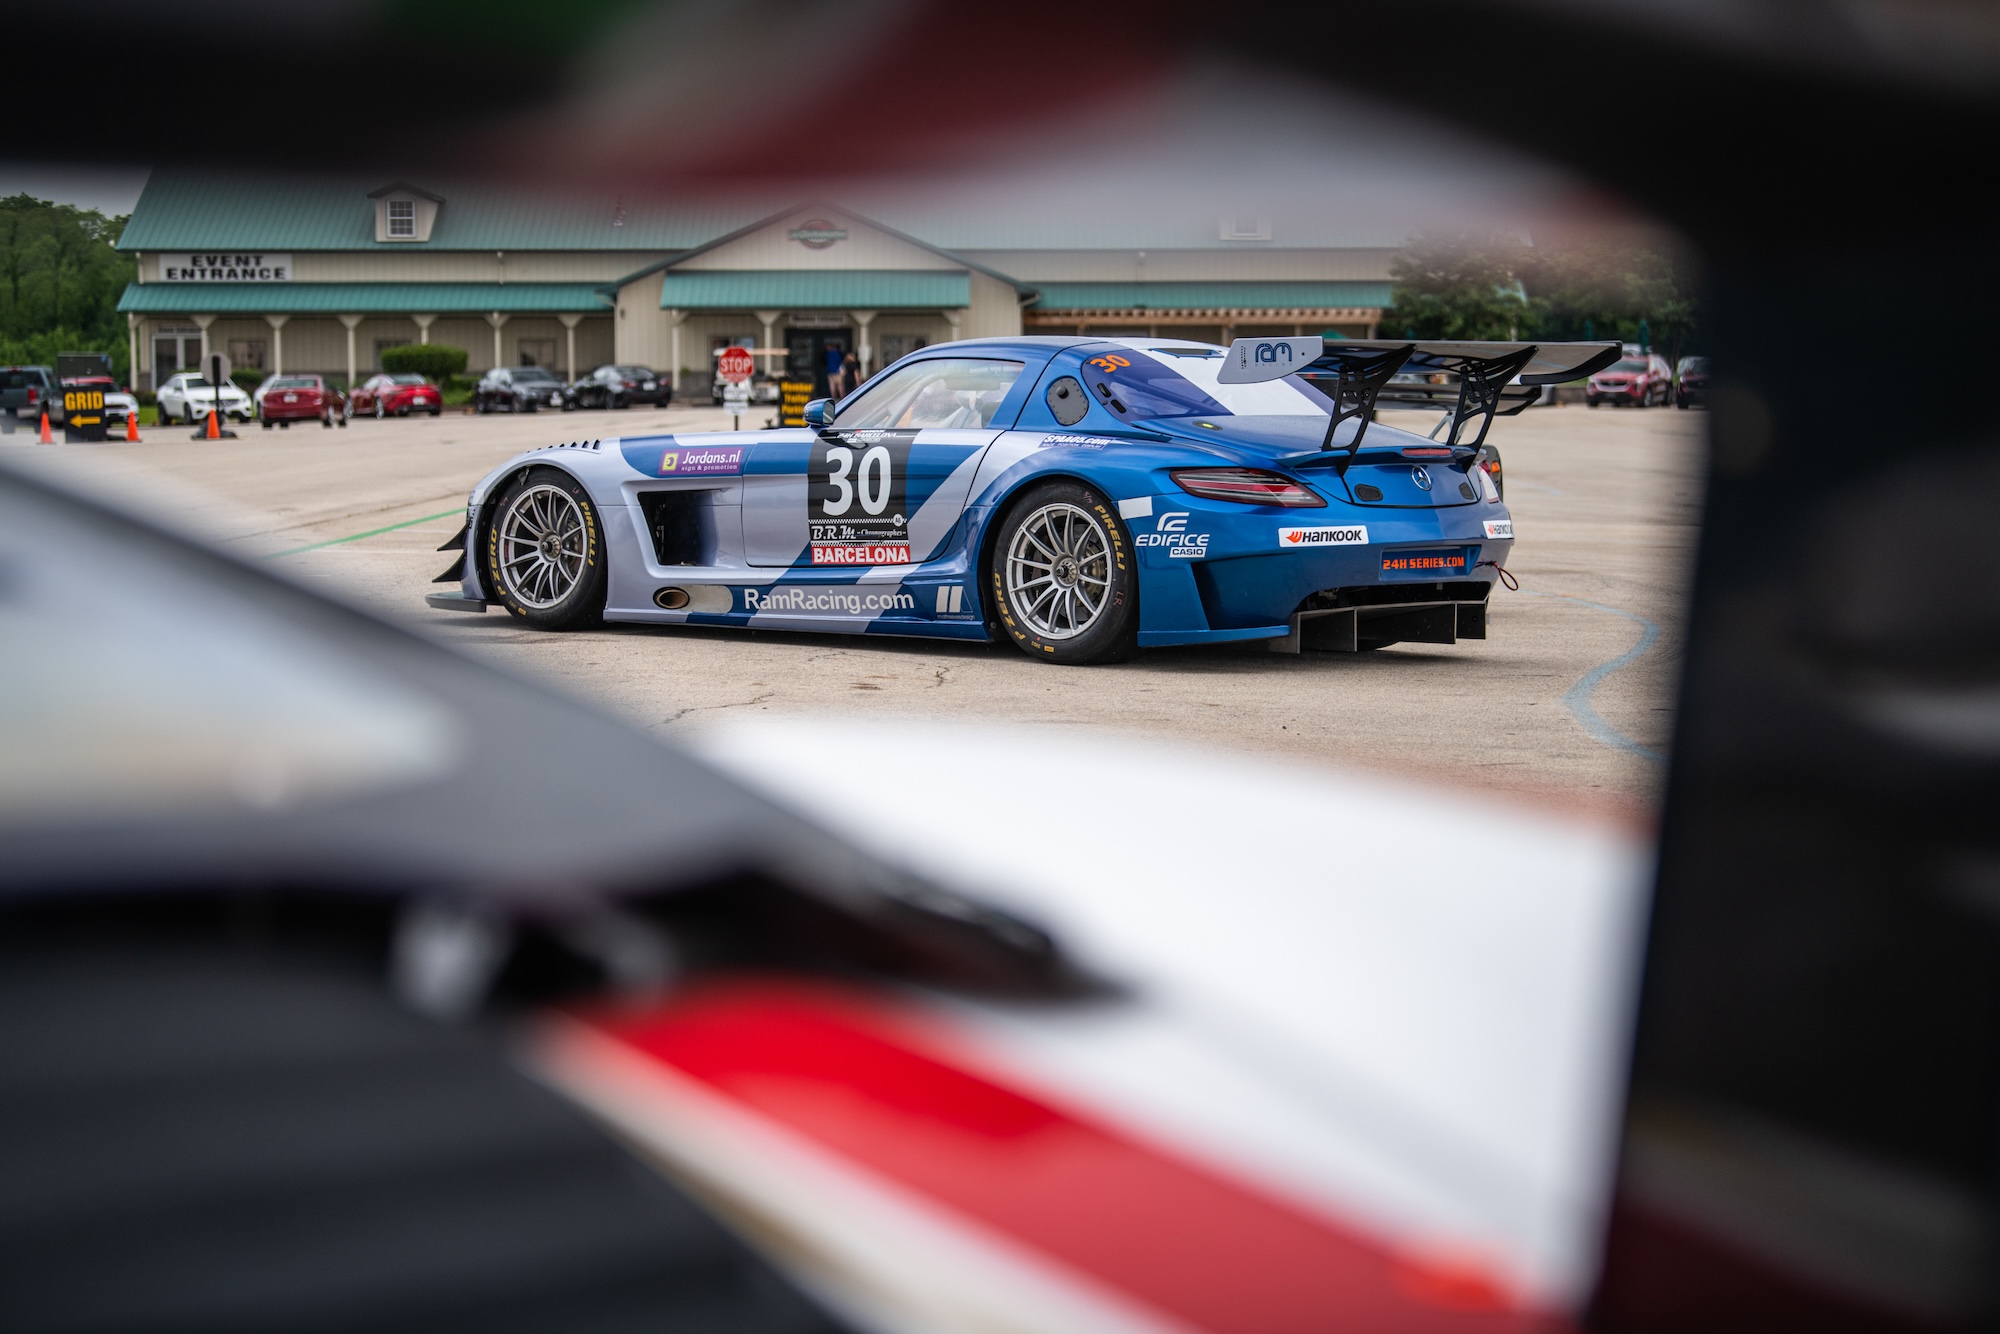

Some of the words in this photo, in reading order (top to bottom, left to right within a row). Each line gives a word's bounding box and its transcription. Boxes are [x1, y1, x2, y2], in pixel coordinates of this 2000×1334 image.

[191, 255, 264, 267] EVENT
[167, 268, 286, 280] ENTRANCE
[720, 357, 752, 373] STOP
[1090, 354, 1131, 373] 30
[64, 390, 104, 411] GRID
[682, 449, 742, 464] Jordans.nl
[822, 445, 892, 516] 30
[580, 501, 597, 567] PIRELLI
[1094, 504, 1126, 570] PIRELLI
[1135, 533, 1211, 547] EDIFICE
[490, 528, 501, 581] ZERO
[813, 547, 909, 563] BARCELONA
[1172, 548, 1204, 556] CASIO
[1383, 558, 1407, 570] 24H
[1409, 556, 1465, 569] SERIES.COM
[744, 588, 915, 614] RamRacing.com
[994, 572, 1016, 627] ZERO
[1014, 630, 1026, 640] P
